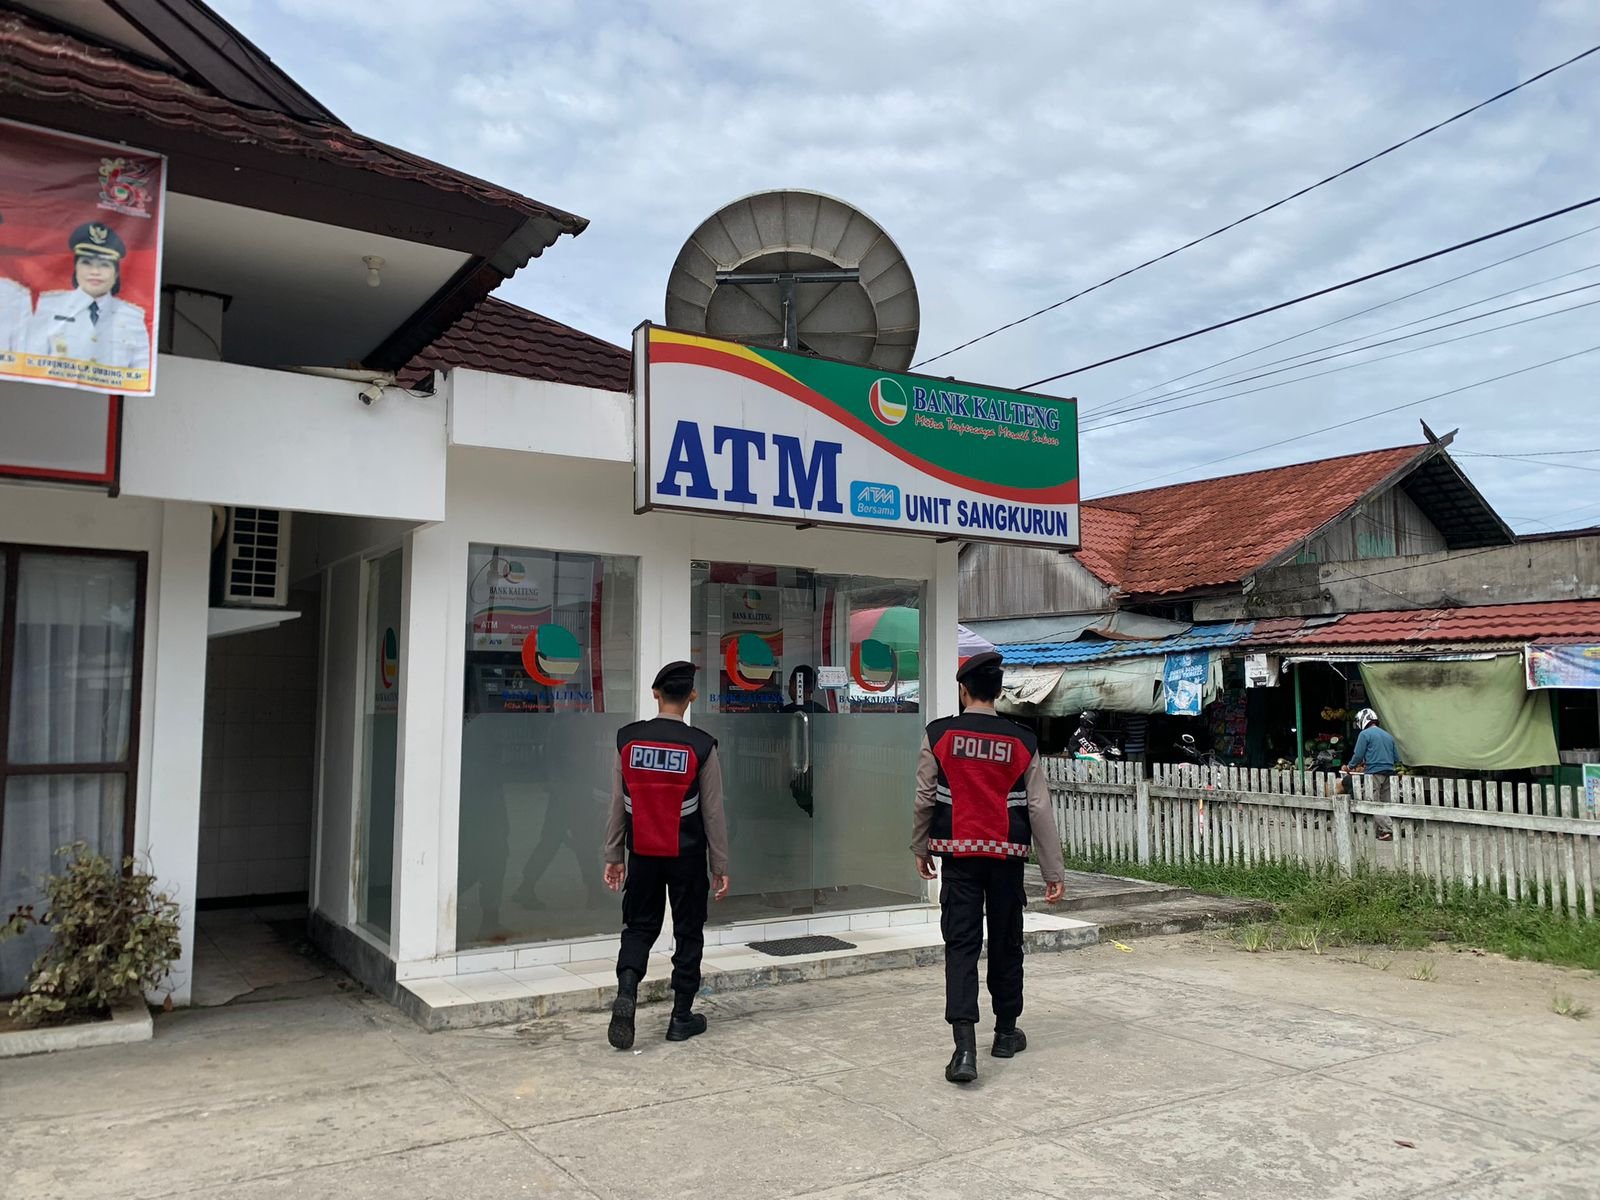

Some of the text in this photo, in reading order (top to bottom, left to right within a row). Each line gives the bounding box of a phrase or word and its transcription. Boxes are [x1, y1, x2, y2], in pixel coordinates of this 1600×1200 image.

[913, 386, 1060, 431] BANK KALTENG
[914, 413, 944, 430] Mitra
[656, 420, 843, 514] ATM
[857, 486, 895, 505] ATM
[857, 502, 895, 517] Bersama
[905, 494, 1068, 537] UNIT SANGKURUN
[489, 586, 539, 597] BANK KALTENG
[481, 621, 498, 629] ATM
[632, 748, 685, 771] POLISI
[952, 735, 1012, 763] POLISI
